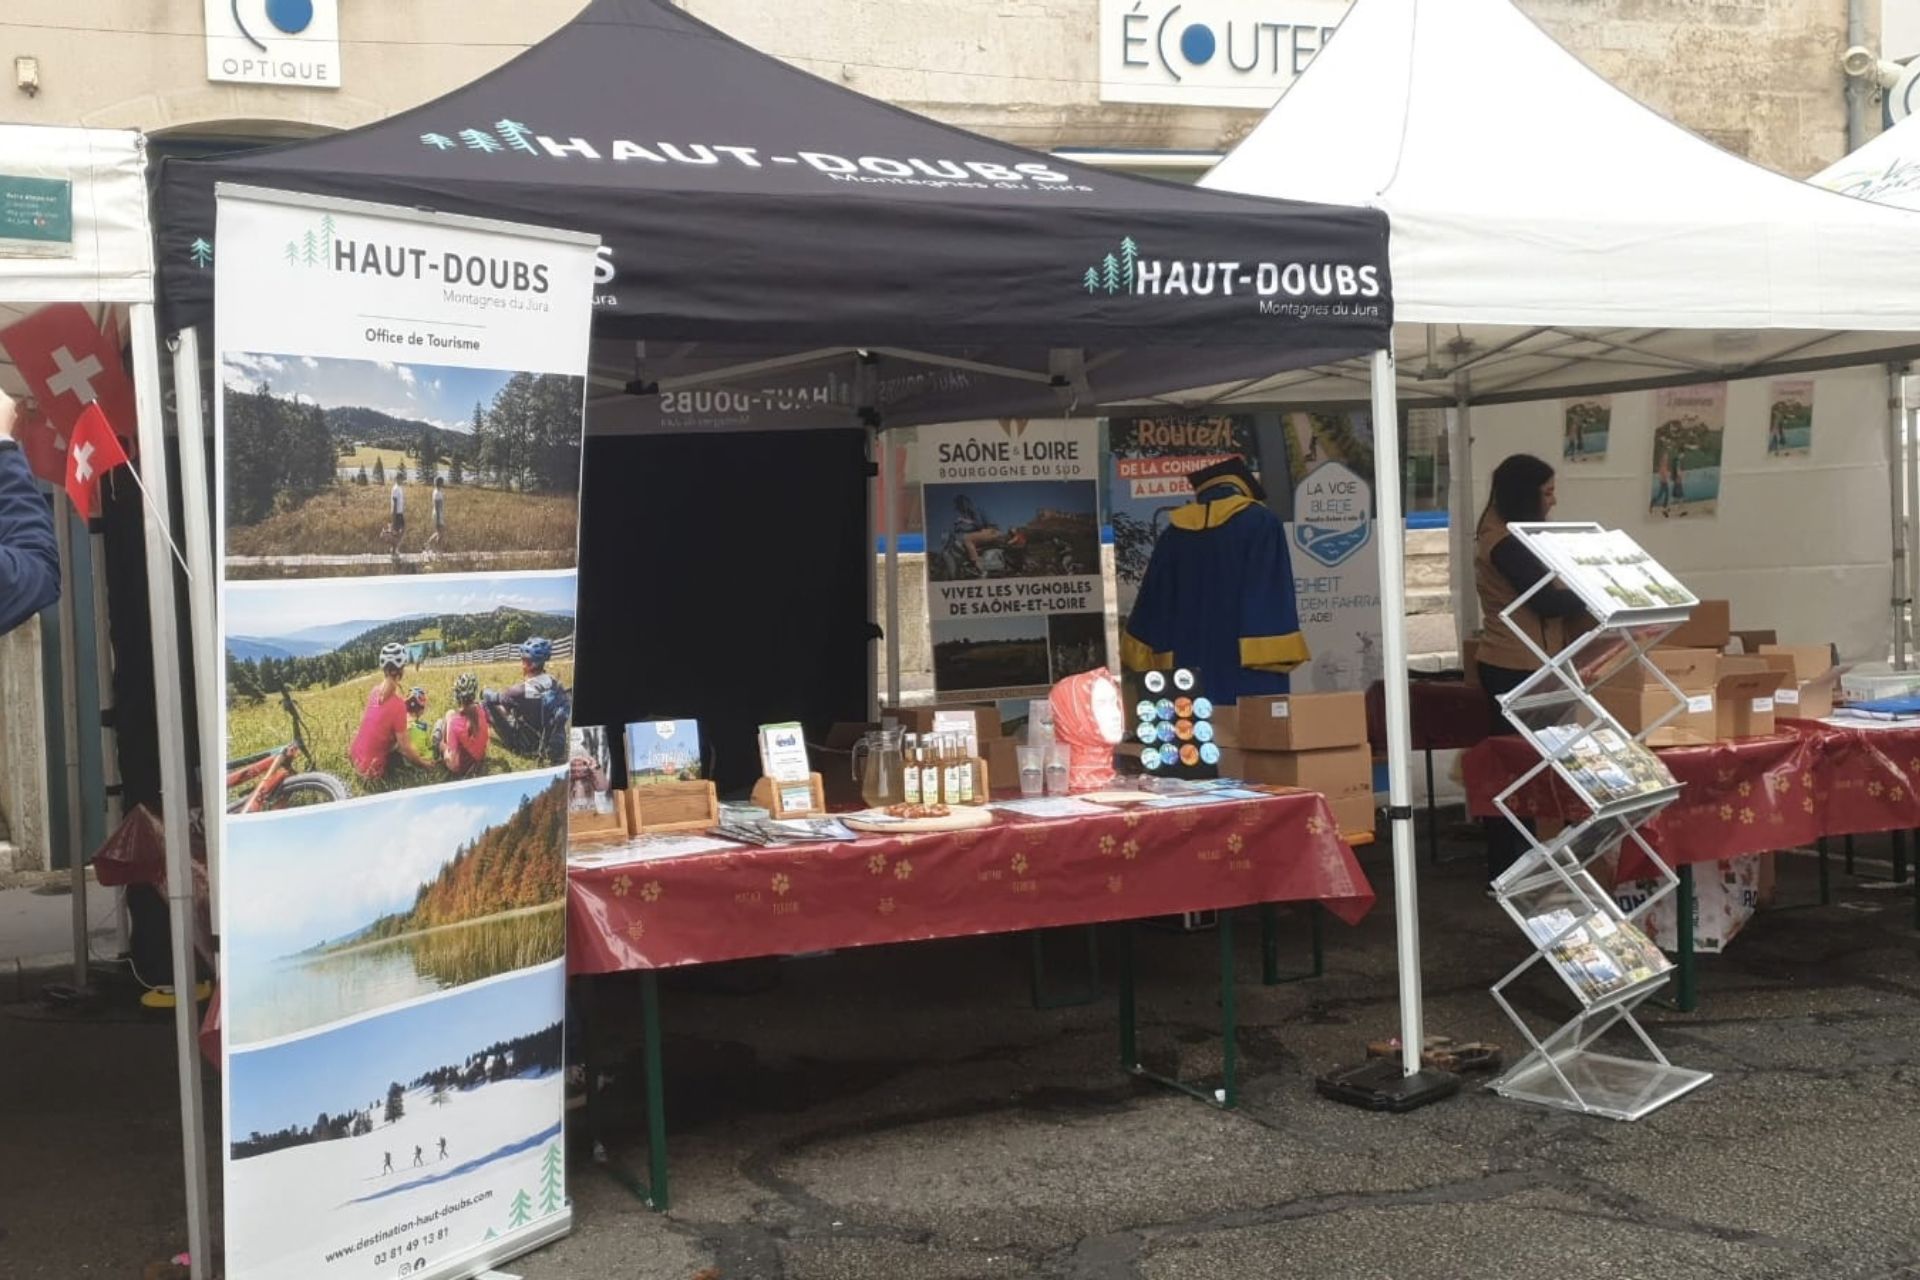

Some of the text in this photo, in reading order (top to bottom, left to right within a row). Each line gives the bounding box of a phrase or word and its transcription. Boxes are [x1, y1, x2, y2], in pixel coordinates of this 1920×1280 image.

[222, 58, 327, 80] OPTIQUE
[536, 135, 1069, 182] HAUT-DOUBS
[827, 172, 988, 189] Montagnes
[334, 239, 549, 293] HAUT-DOUBS
[1137, 260, 1379, 297] HAUT-DOUBS
[443, 289, 549, 312] Montagnes du Jura
[592, 295, 617, 305] ura
[1259, 300, 1378, 318] Montagnes du Jura
[365, 328, 480, 350] Office de Tourisme
[939, 438, 1010, 463] SAÔNE
[1023, 441, 1079, 460] LOIRE
[940, 464, 1080, 478] BOURGOGNE DU SUD
[1120, 463, 1136, 475] DE
[1141, 462, 1158, 475] LA
[1149, 482, 1165, 493] LA
[1306, 482, 1323, 495] LA
[941, 581, 1092, 599] VIVEZ LES VIGNOBLES
[950, 597, 1086, 615] DE SAÔNE-ET-LOIRE
[1332, 595, 1381, 608] FAHRRA
[325, 1189, 493, 1263] www.destination-haut-doubs.com
[374, 1227, 449, 1265] 03 81 49 13 81
